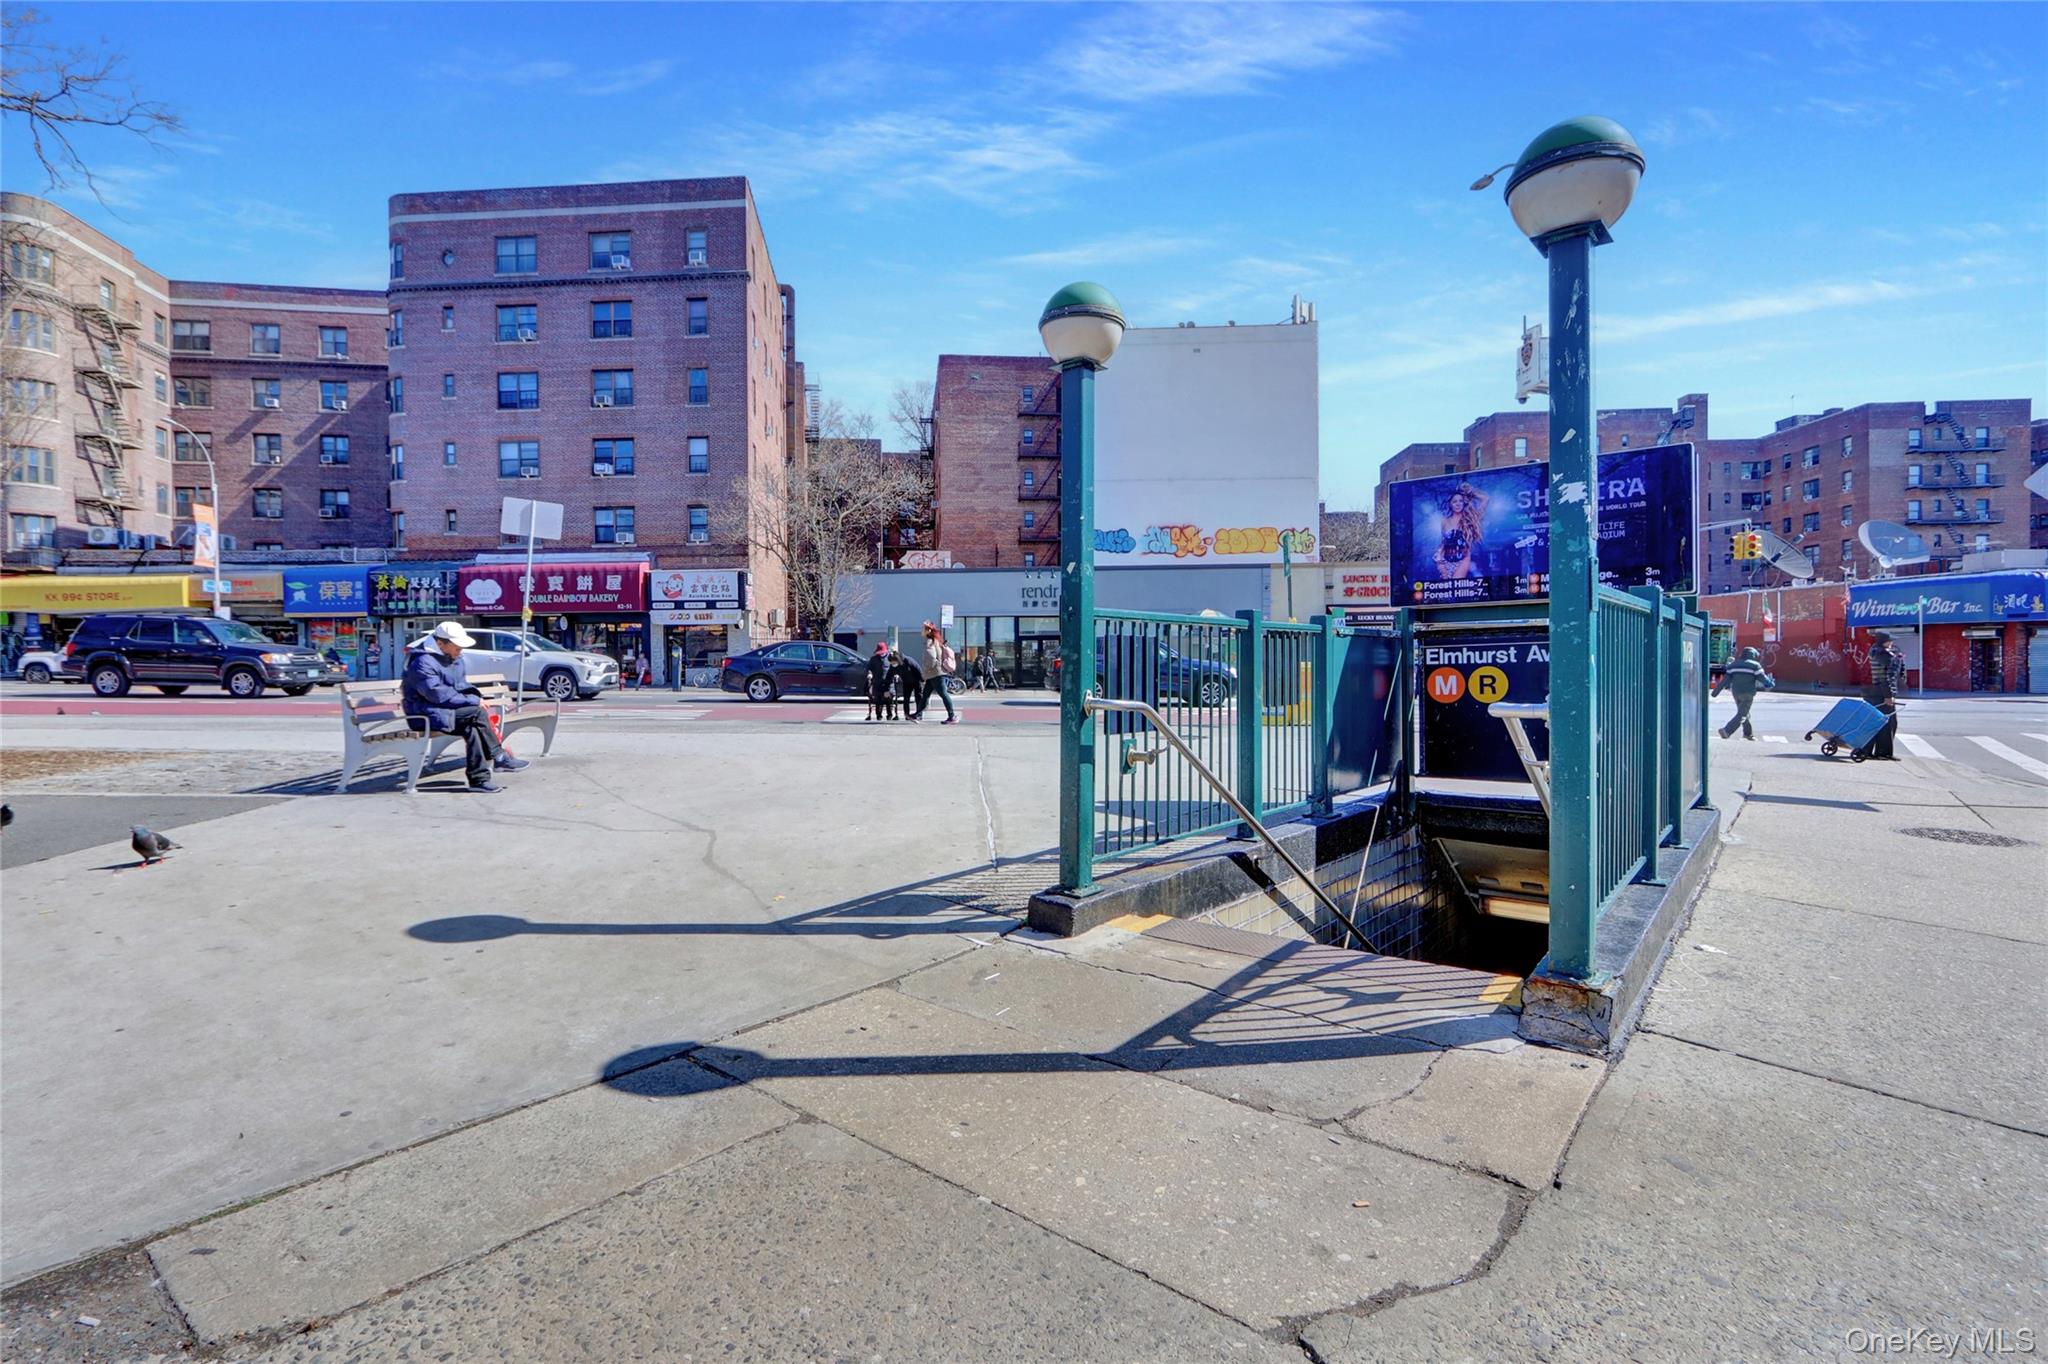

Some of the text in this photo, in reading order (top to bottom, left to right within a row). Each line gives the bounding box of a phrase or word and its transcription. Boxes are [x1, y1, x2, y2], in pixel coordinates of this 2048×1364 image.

[1645, 567, 1660, 576] 3m
[1424, 580, 1452, 590] Forest
[1514, 576, 1527, 584] 1m
[45, 593, 57, 601] KK
[87, 592, 120, 601] STORE
[553, 594, 588, 603] RAINBOW
[589, 593, 619, 603] BAKERY
[1022, 584, 1059, 598] rendr
[1424, 590, 1452, 600] Forest
[1513, 585, 1527, 594] 3m
[1926, 596, 1961, 615] Bar
[1963, 602, 1984, 613] Inc.
[1426, 645, 1549, 665] Elmhurst Av
[1435, 674, 1497, 696] M R
